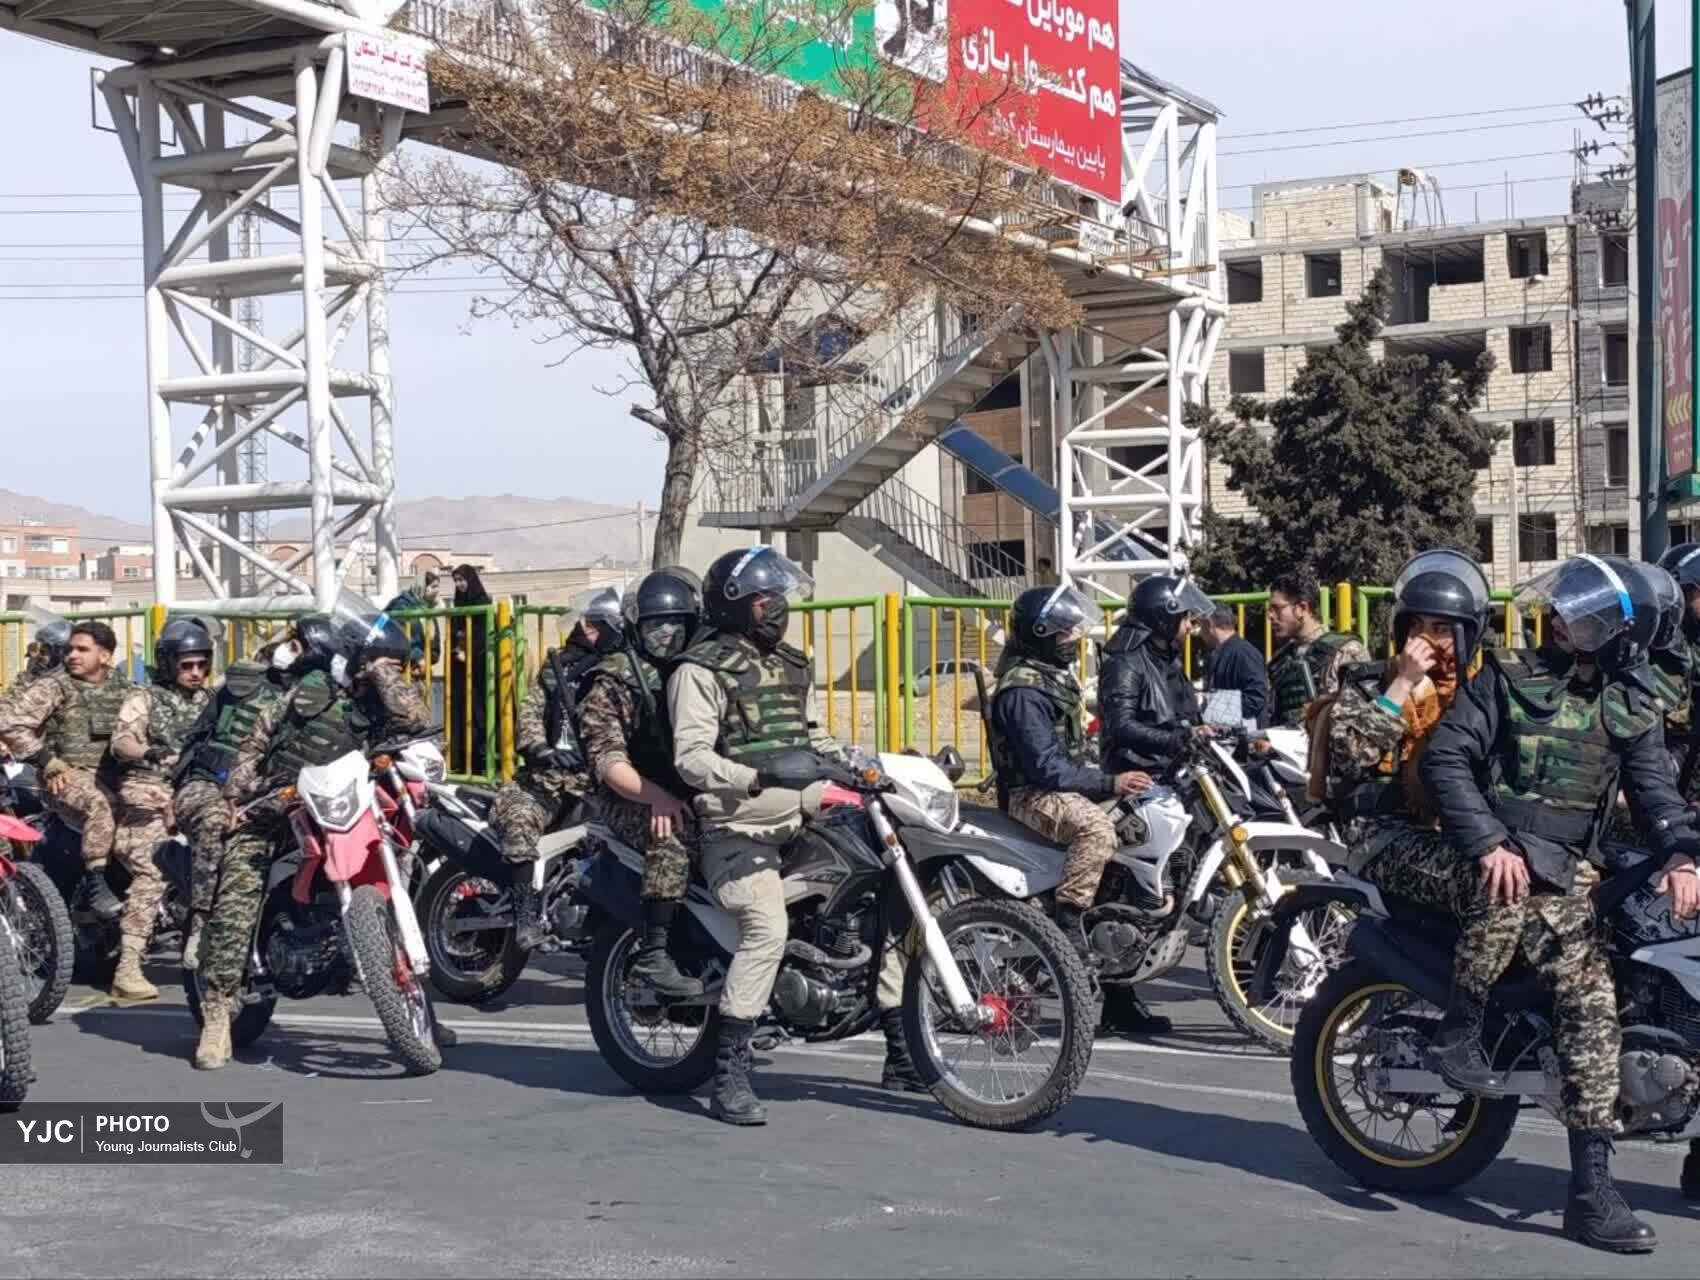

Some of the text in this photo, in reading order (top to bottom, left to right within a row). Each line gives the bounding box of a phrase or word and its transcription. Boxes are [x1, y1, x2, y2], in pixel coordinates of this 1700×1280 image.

[961, 27, 1010, 79] بازی
[1087, 17, 1115, 51] هم
[1088, 82, 1117, 119] هم
[1016, 119, 1076, 167] بیمارستان
